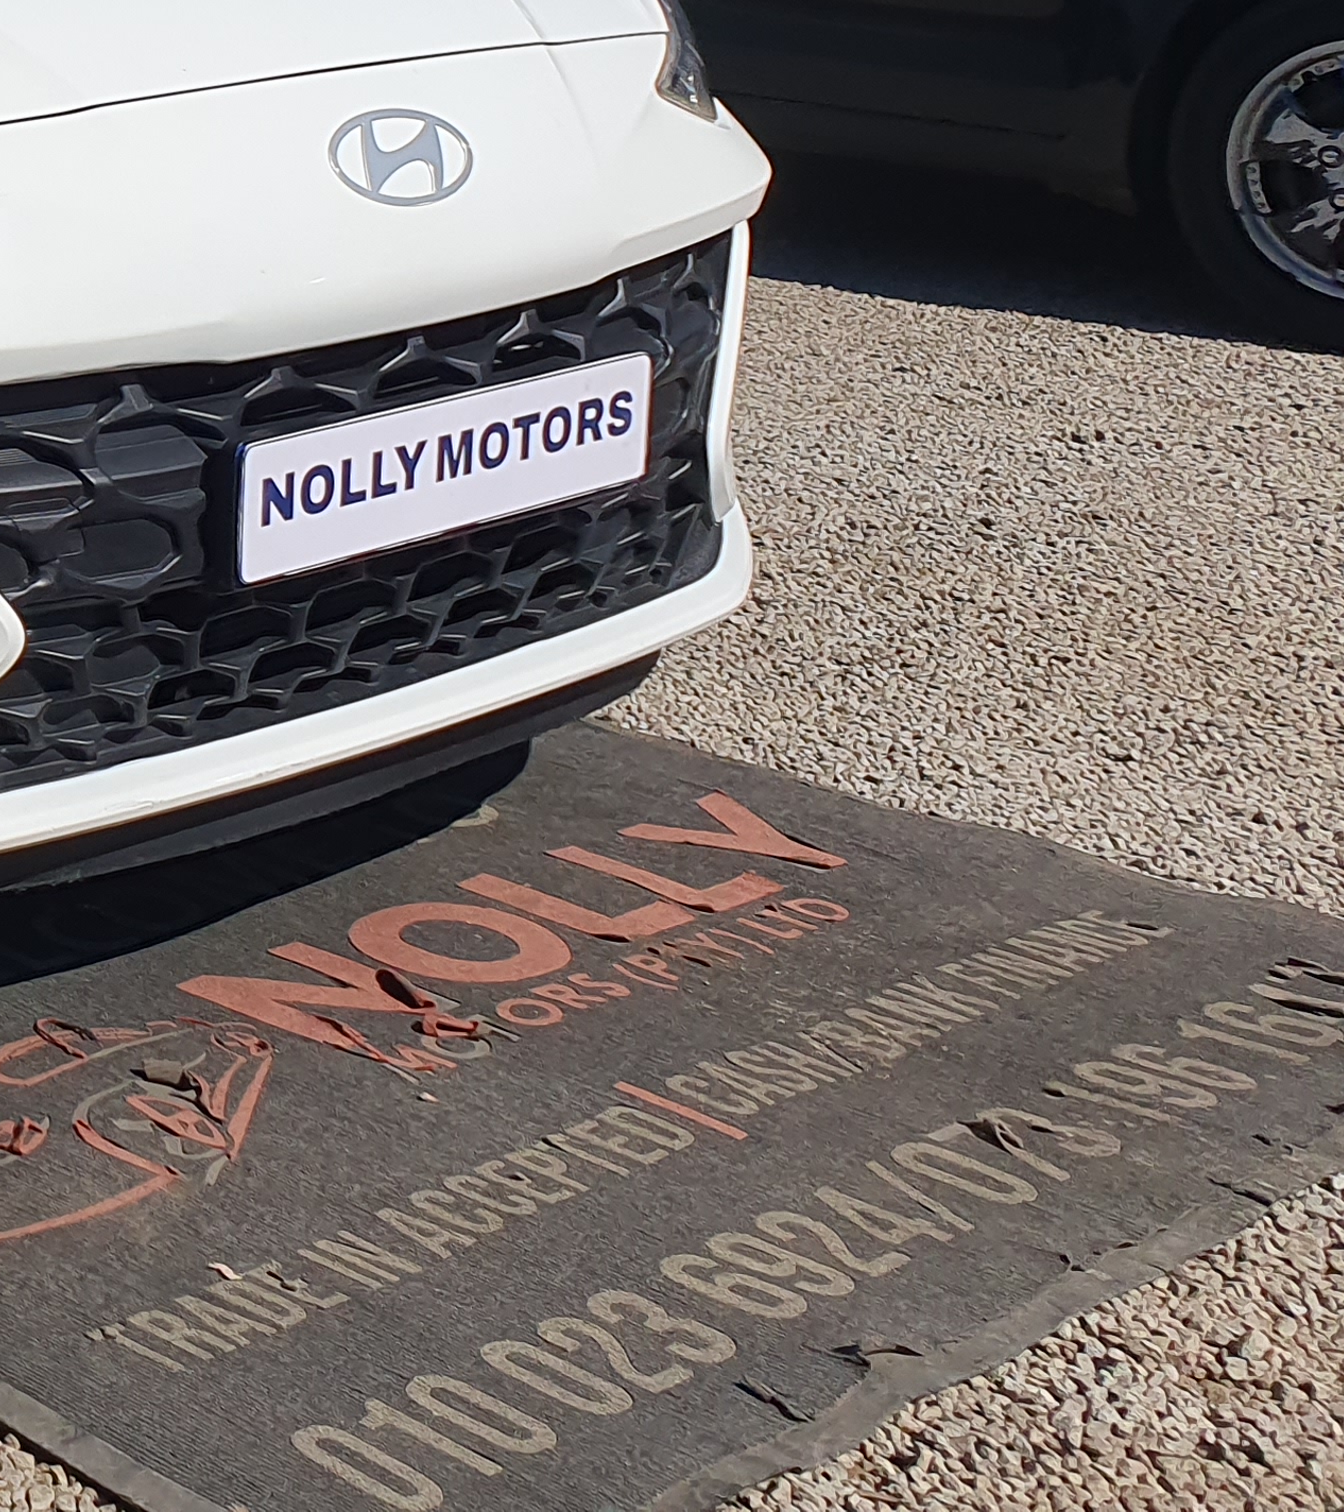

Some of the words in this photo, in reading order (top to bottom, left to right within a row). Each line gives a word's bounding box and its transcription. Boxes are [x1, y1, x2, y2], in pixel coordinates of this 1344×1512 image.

[259, 439, 428, 527] NOLLY
[435, 390, 634, 483] MOTORS
[177, 790, 848, 1071] NOLLY
[85, 1260, 350, 1373] TRADE
[296, 1229, 423, 1288] IN
[375, 1104, 695, 1259] ACCEPTED
[934, 909, 1177, 1000] FINANCE
[290, 1374, 558, 1512] 010
[480, 1289, 738, 1416] 023
[1045, 1043, 1258, 1123] 196
